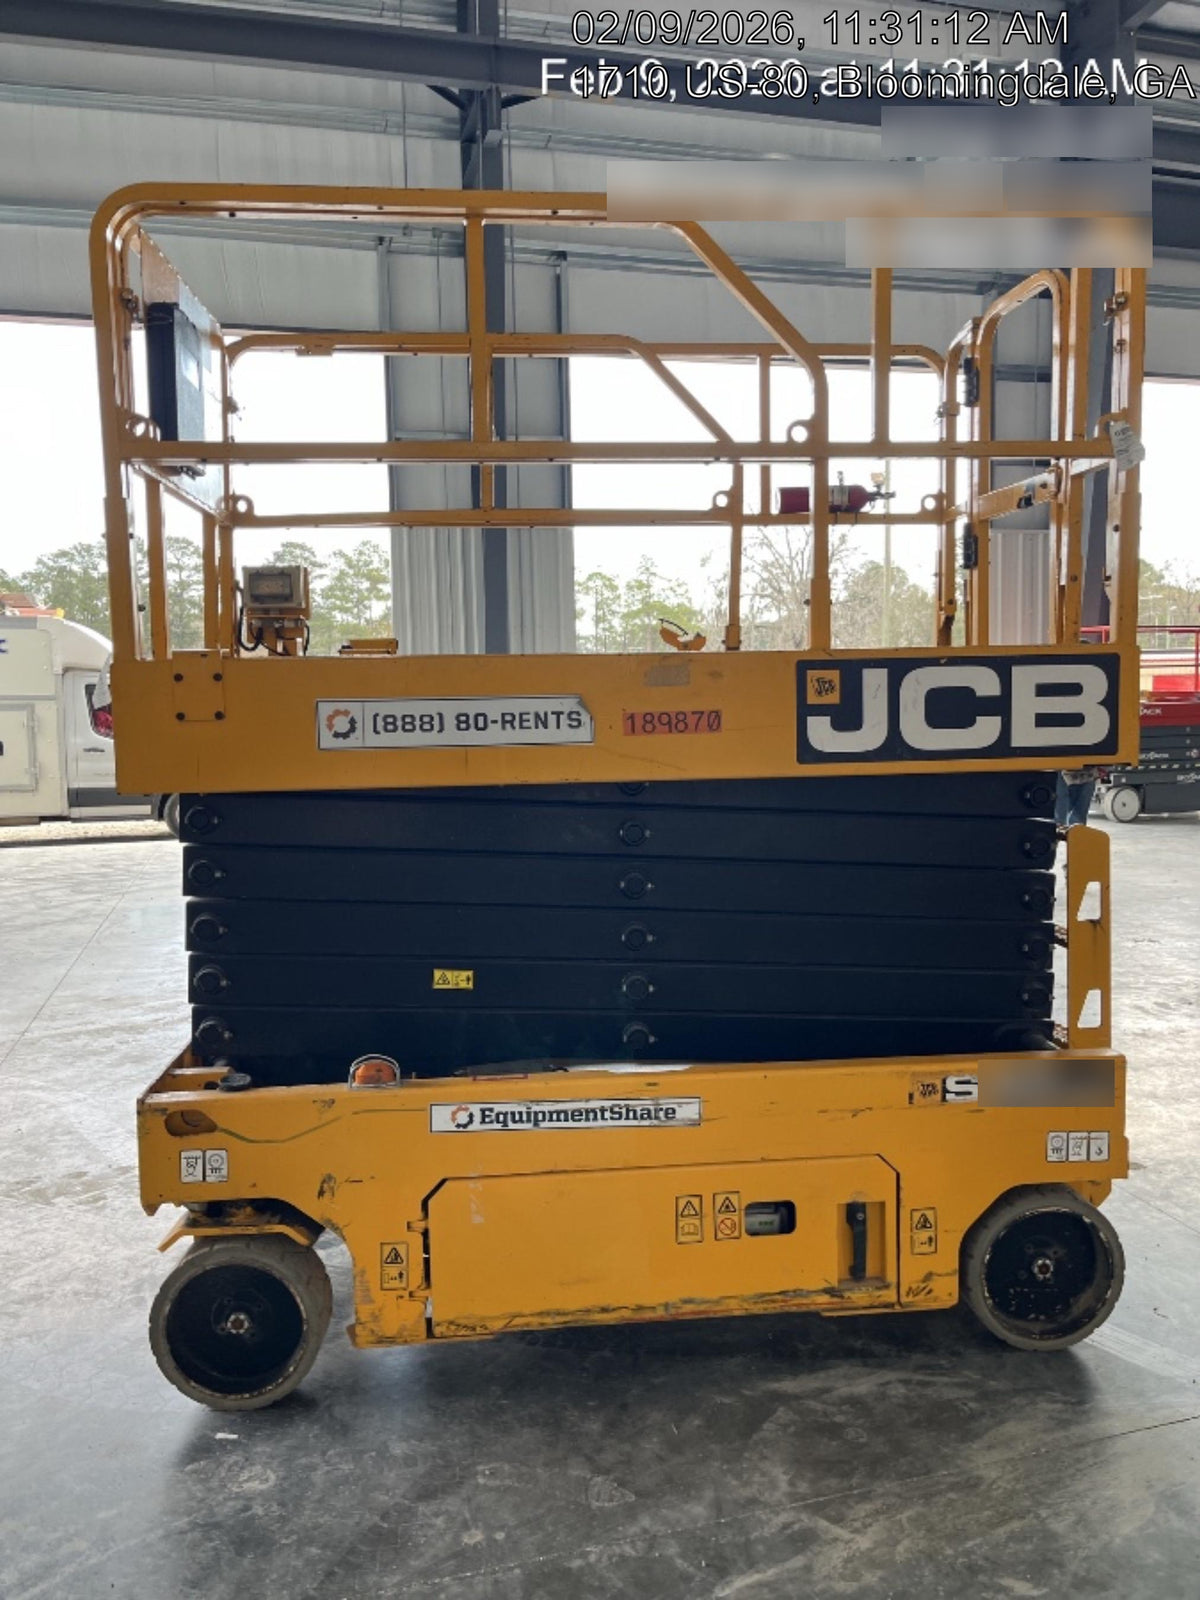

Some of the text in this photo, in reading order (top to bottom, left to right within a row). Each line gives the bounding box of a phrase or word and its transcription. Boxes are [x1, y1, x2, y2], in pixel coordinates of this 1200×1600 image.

[806, 664, 1111, 753] JCB
[372, 710, 583, 735] (888) 80-RENTS
[626, 710, 721, 734] 189870
[479, 1104, 677, 1128] EquipmentShare
